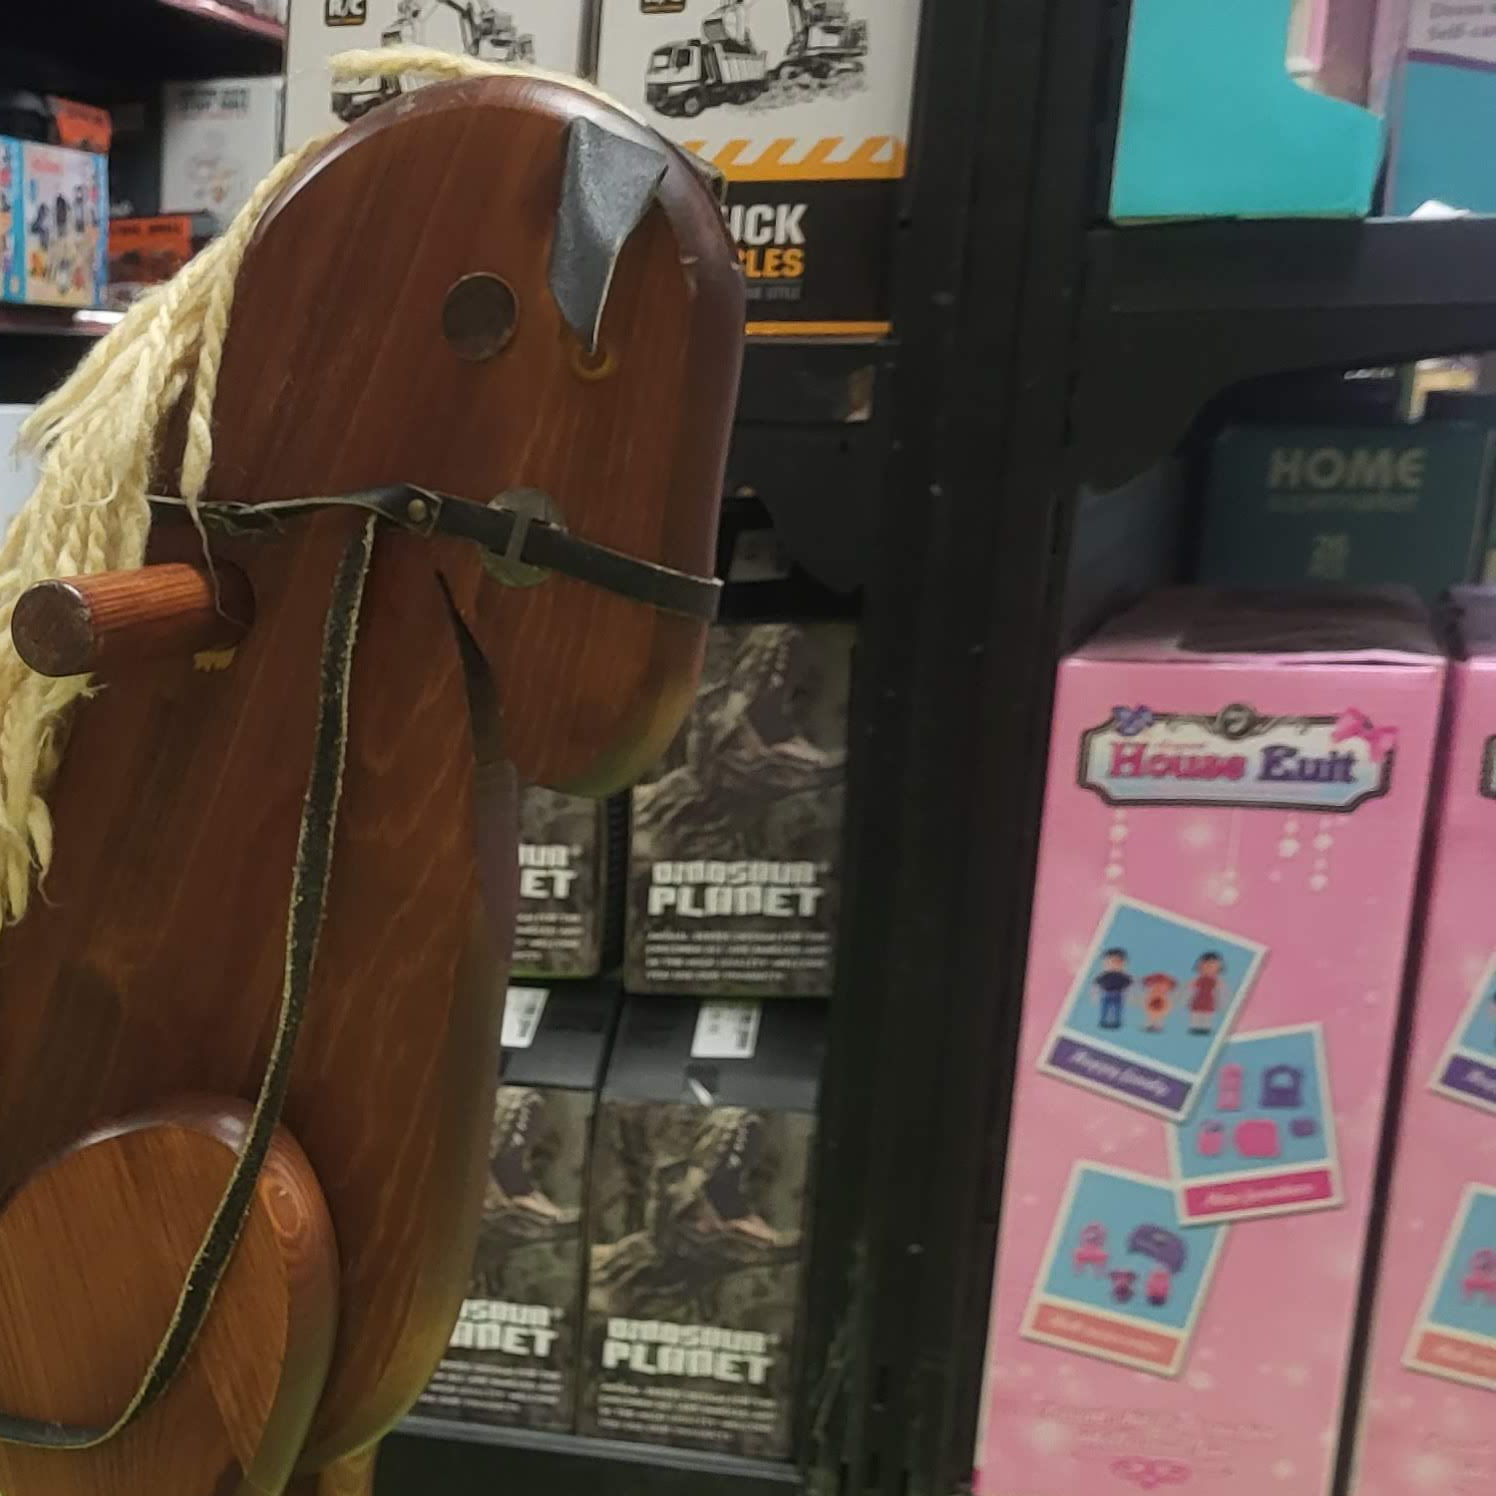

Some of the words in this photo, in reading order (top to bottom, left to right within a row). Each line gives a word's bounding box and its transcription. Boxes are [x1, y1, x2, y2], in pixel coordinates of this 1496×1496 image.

[1266, 447, 1428, 490] HOME
[1107, 742, 1246, 781] House
[647, 884, 826, 918] PLANET
[601, 1338, 775, 1385] PLANET
